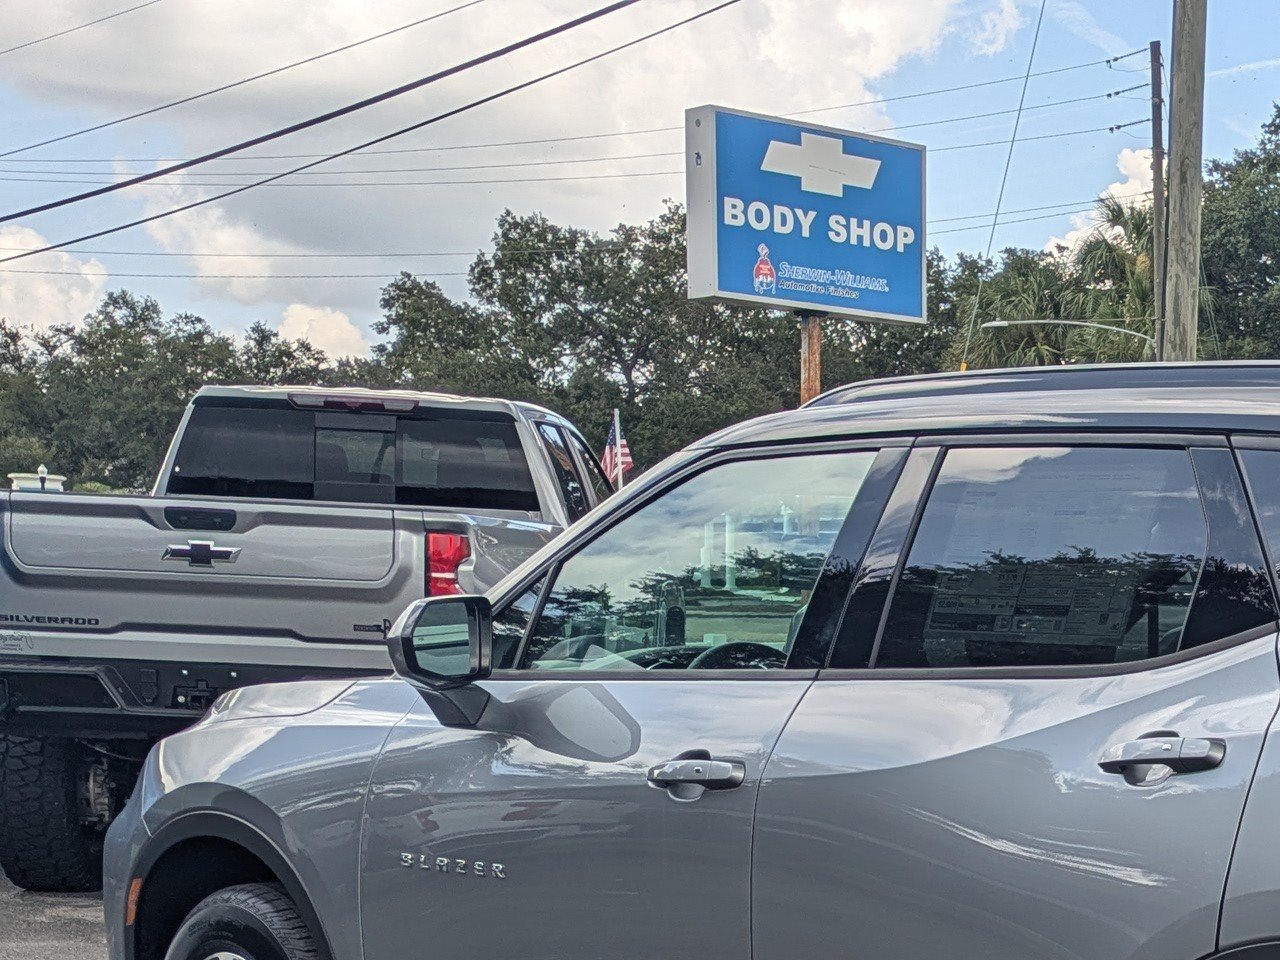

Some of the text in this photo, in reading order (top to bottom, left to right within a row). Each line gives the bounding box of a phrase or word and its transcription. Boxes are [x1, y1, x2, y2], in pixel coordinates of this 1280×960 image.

[723, 196, 915, 253] BODY SHOP
[779, 279, 859, 299] Automotive Finishes
[0, 614, 99, 625] SILVERADO
[400, 852, 506, 879] BLAZER
